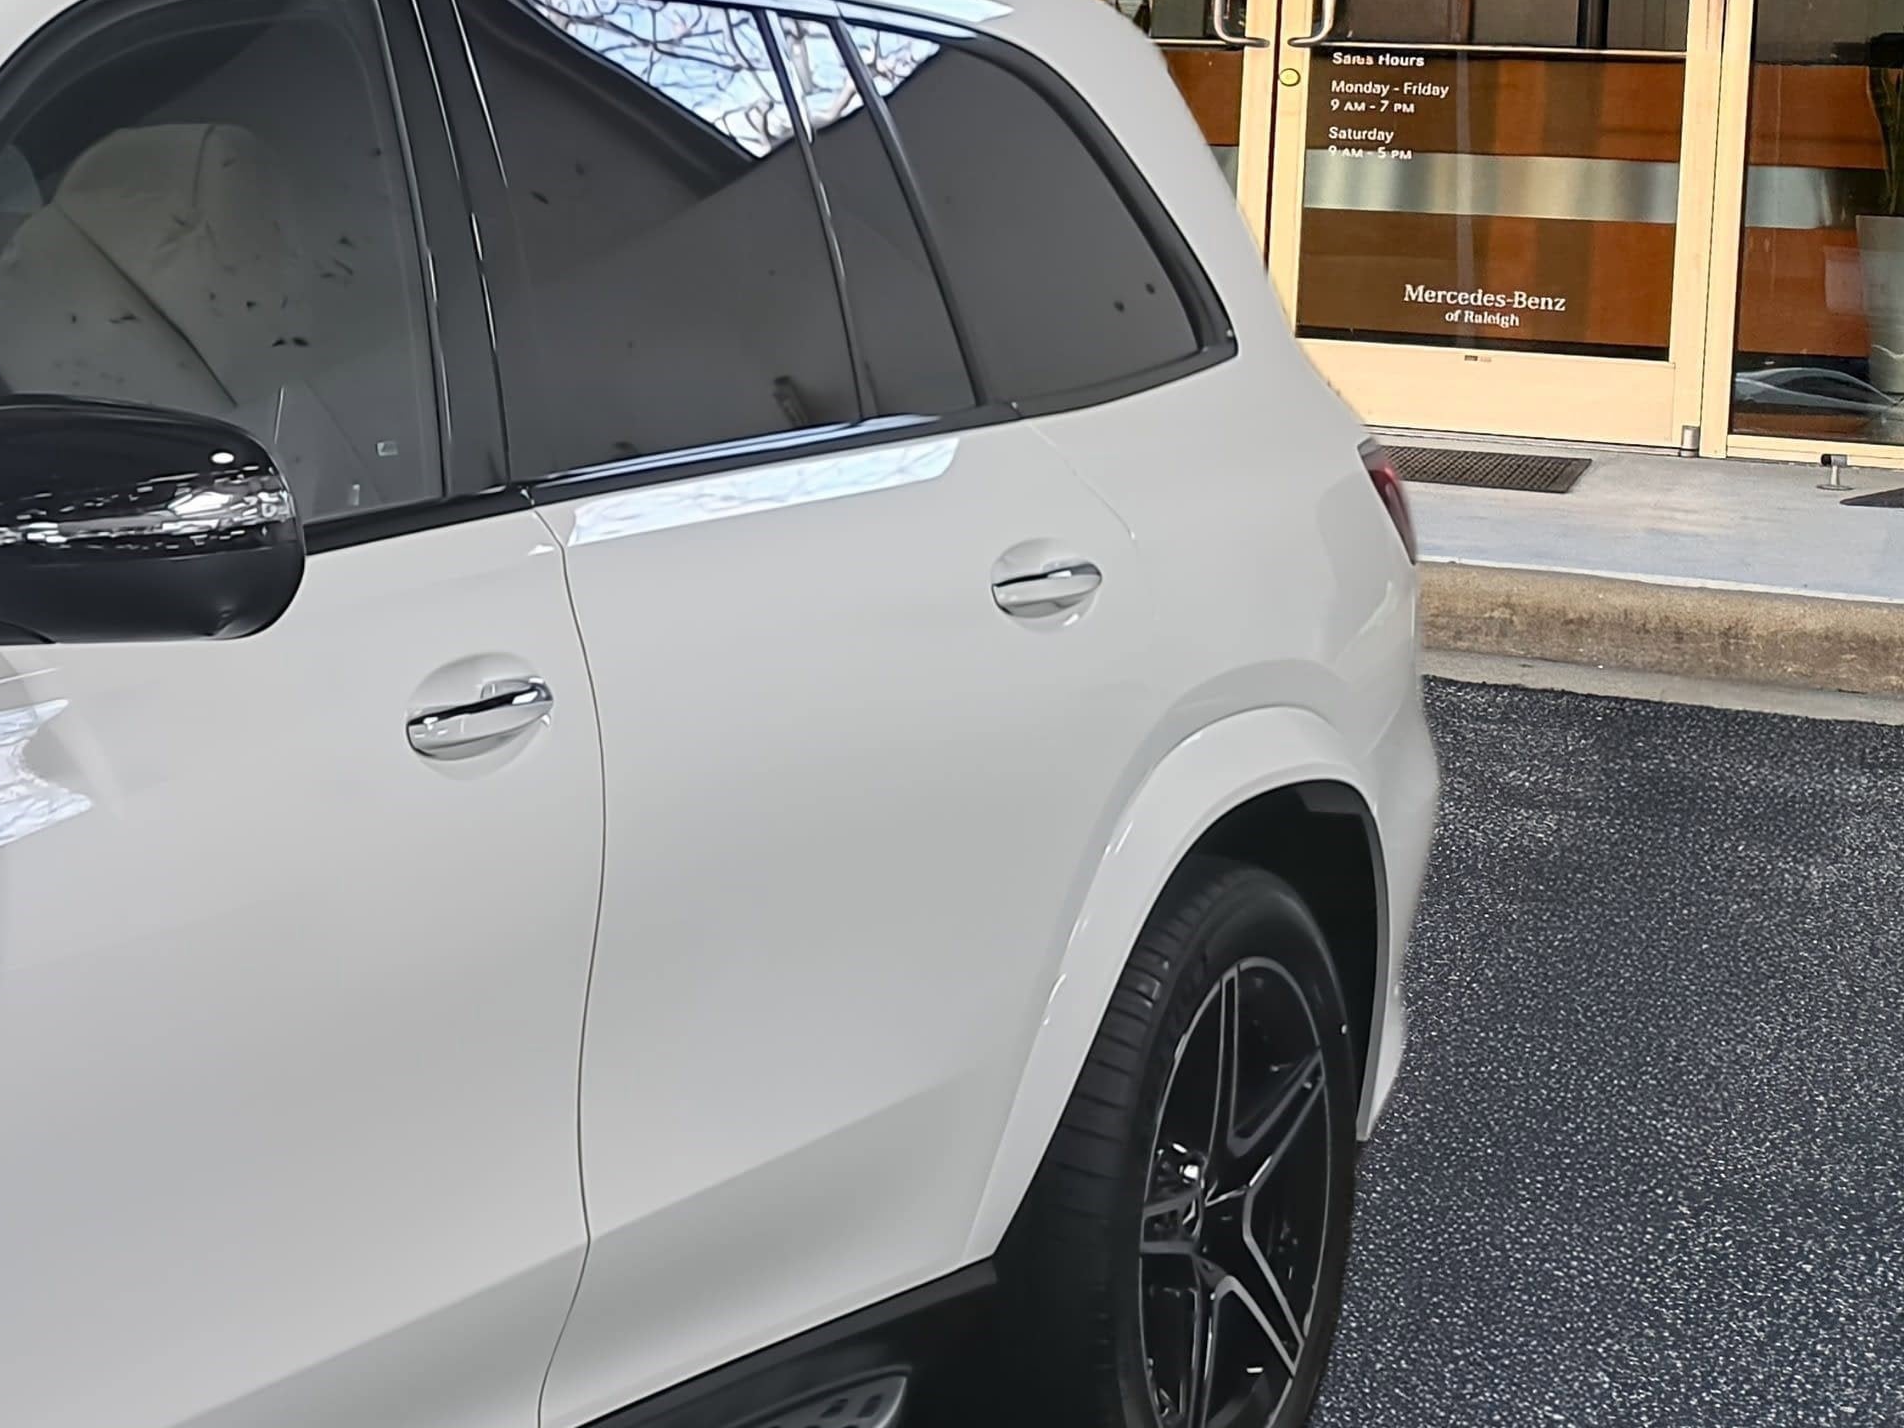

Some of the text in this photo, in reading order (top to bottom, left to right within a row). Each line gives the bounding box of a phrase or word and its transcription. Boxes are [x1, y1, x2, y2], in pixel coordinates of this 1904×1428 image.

[1377, 53, 1425, 67] Hours
[1331, 80, 1390, 97] Monday
[1403, 82, 1449, 99] Friday
[1330, 98, 1340, 111] 9
[1344, 101, 1366, 112] AM
[1379, 100, 1389, 112] 7
[1393, 103, 1415, 114] PM
[1328, 126, 1394, 144] Saturday
[1328, 145, 1337, 157] 9
[1377, 146, 1387, 159] 5
[1391, 149, 1412, 160] PM
[1403, 283, 1566, 312] Mercedes-Benz
[1444, 309, 1461, 322] of
